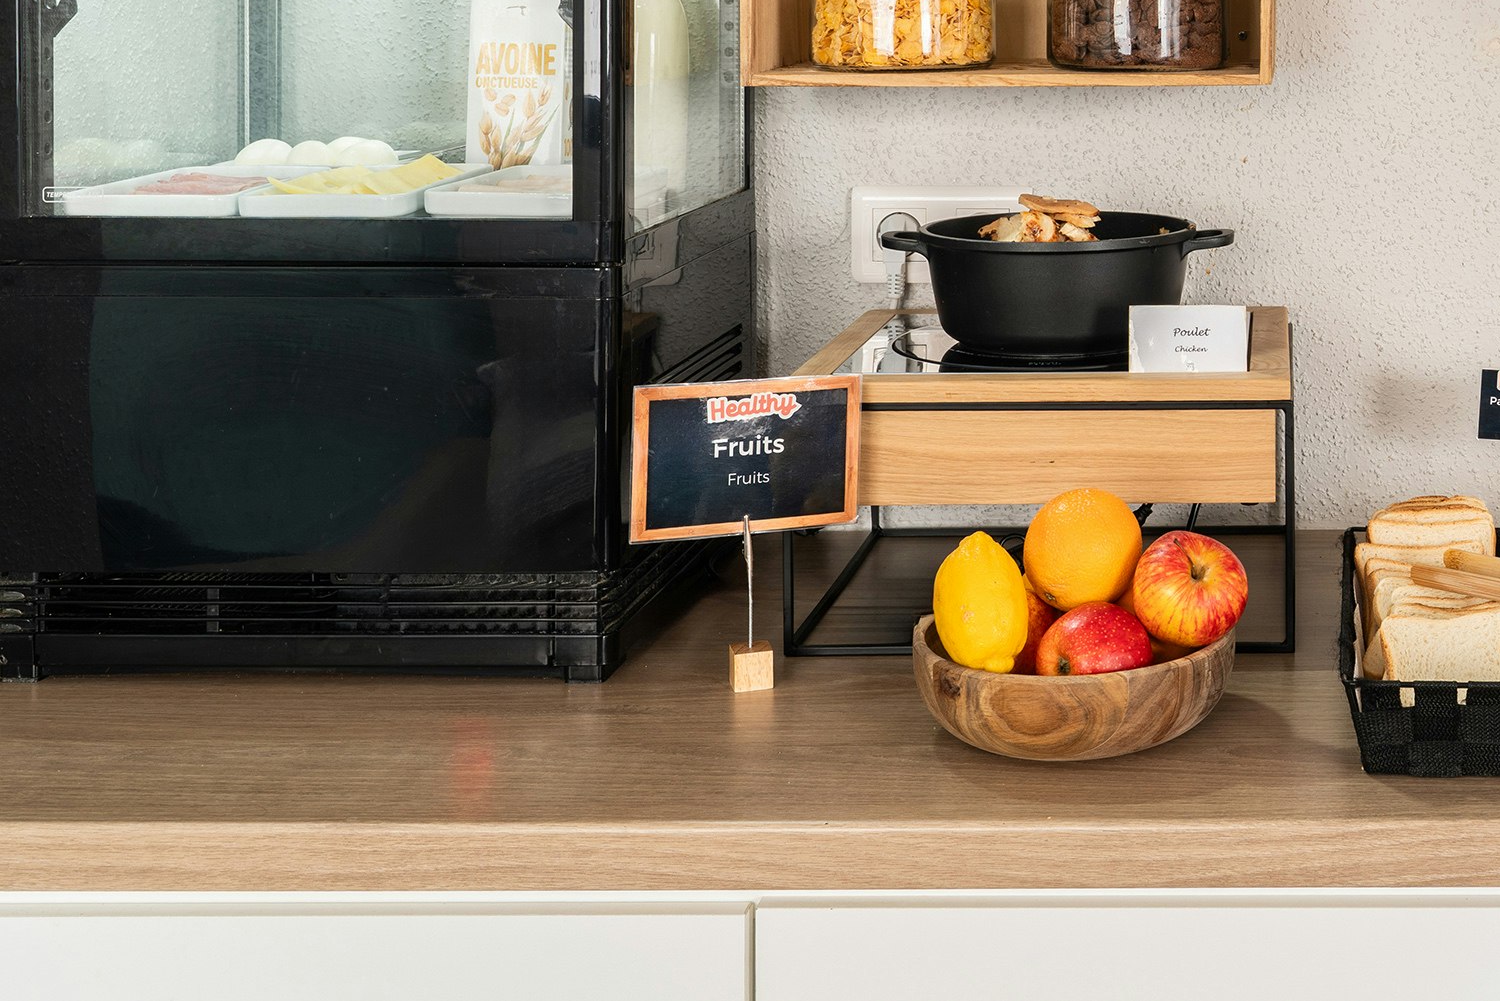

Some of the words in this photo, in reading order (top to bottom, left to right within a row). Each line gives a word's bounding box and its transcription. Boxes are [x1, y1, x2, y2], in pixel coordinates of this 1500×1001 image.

[476, 41, 557, 76] AVOINE
[476, 76, 538, 89] ONCTUEUSE
[1173, 327, 1211, 337] Poulet
[1174, 345, 1208, 353] Chicken
[709, 393, 799, 422] Healthy
[712, 434, 785, 459] Fruits
[727, 471, 770, 486] Fruits
